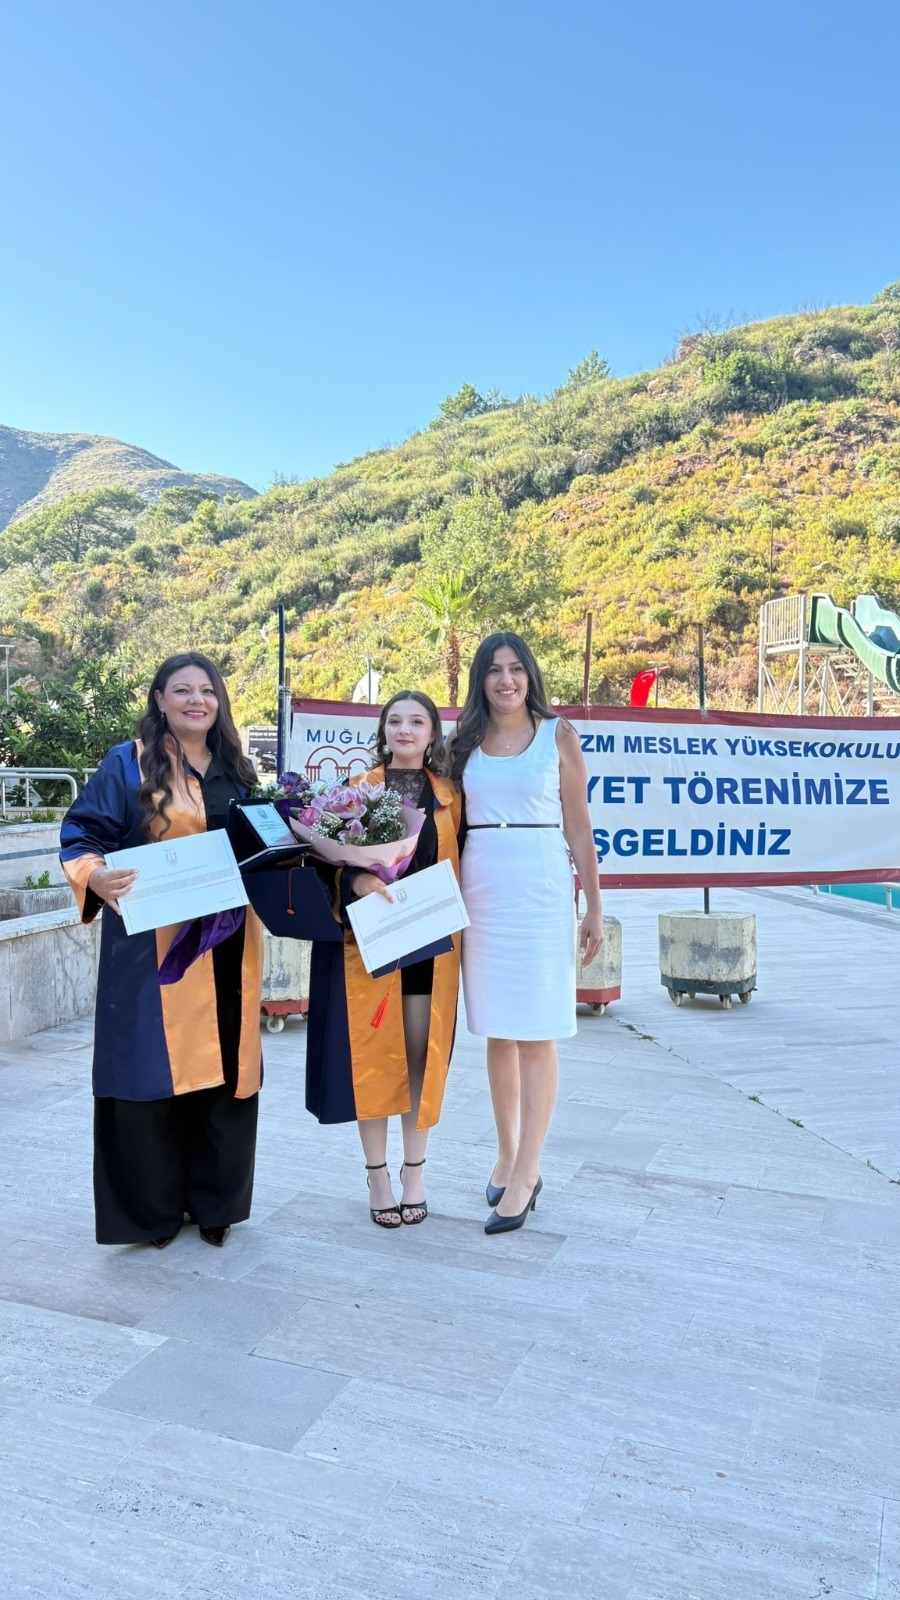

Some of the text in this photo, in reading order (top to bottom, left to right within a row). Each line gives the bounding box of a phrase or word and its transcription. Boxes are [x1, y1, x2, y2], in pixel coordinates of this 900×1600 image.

[624, 735, 719, 756] MESLEK
[724, 735, 900, 759] YÜKSEKOKULU
[663, 771, 890, 805] TÖRENİMİZE
[592, 821, 792, 864] ŞGELDİNİZ
